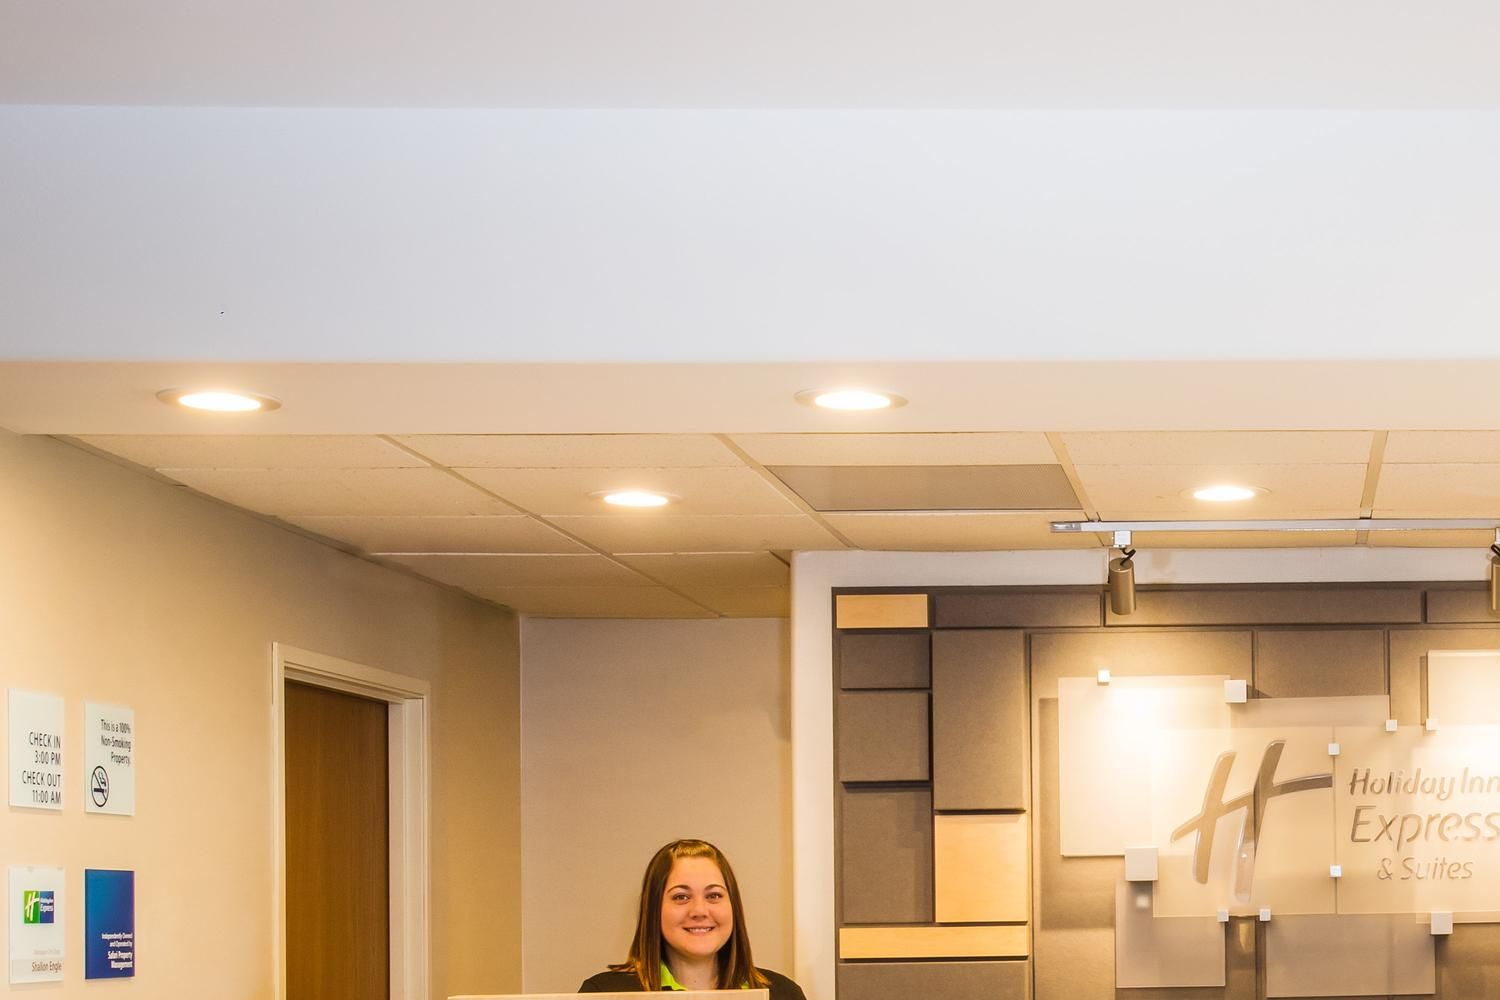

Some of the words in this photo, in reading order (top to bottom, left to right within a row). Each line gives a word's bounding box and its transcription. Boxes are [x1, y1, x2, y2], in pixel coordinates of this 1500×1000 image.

[29, 731, 51, 747] CHECK
[53, 735, 61, 749] IN
[34, 750, 49, 764] 3:00
[51, 752, 61, 765] PM
[22, 770, 45, 785] CHECK
[47, 772, 61, 787] OUT
[1349, 767, 1456, 801] Holiday
[32, 789, 48, 803] 11:00
[50, 791, 61, 804] AM
[1377, 857, 1393, 881] &
[1400, 856, 1474, 881] Suites
